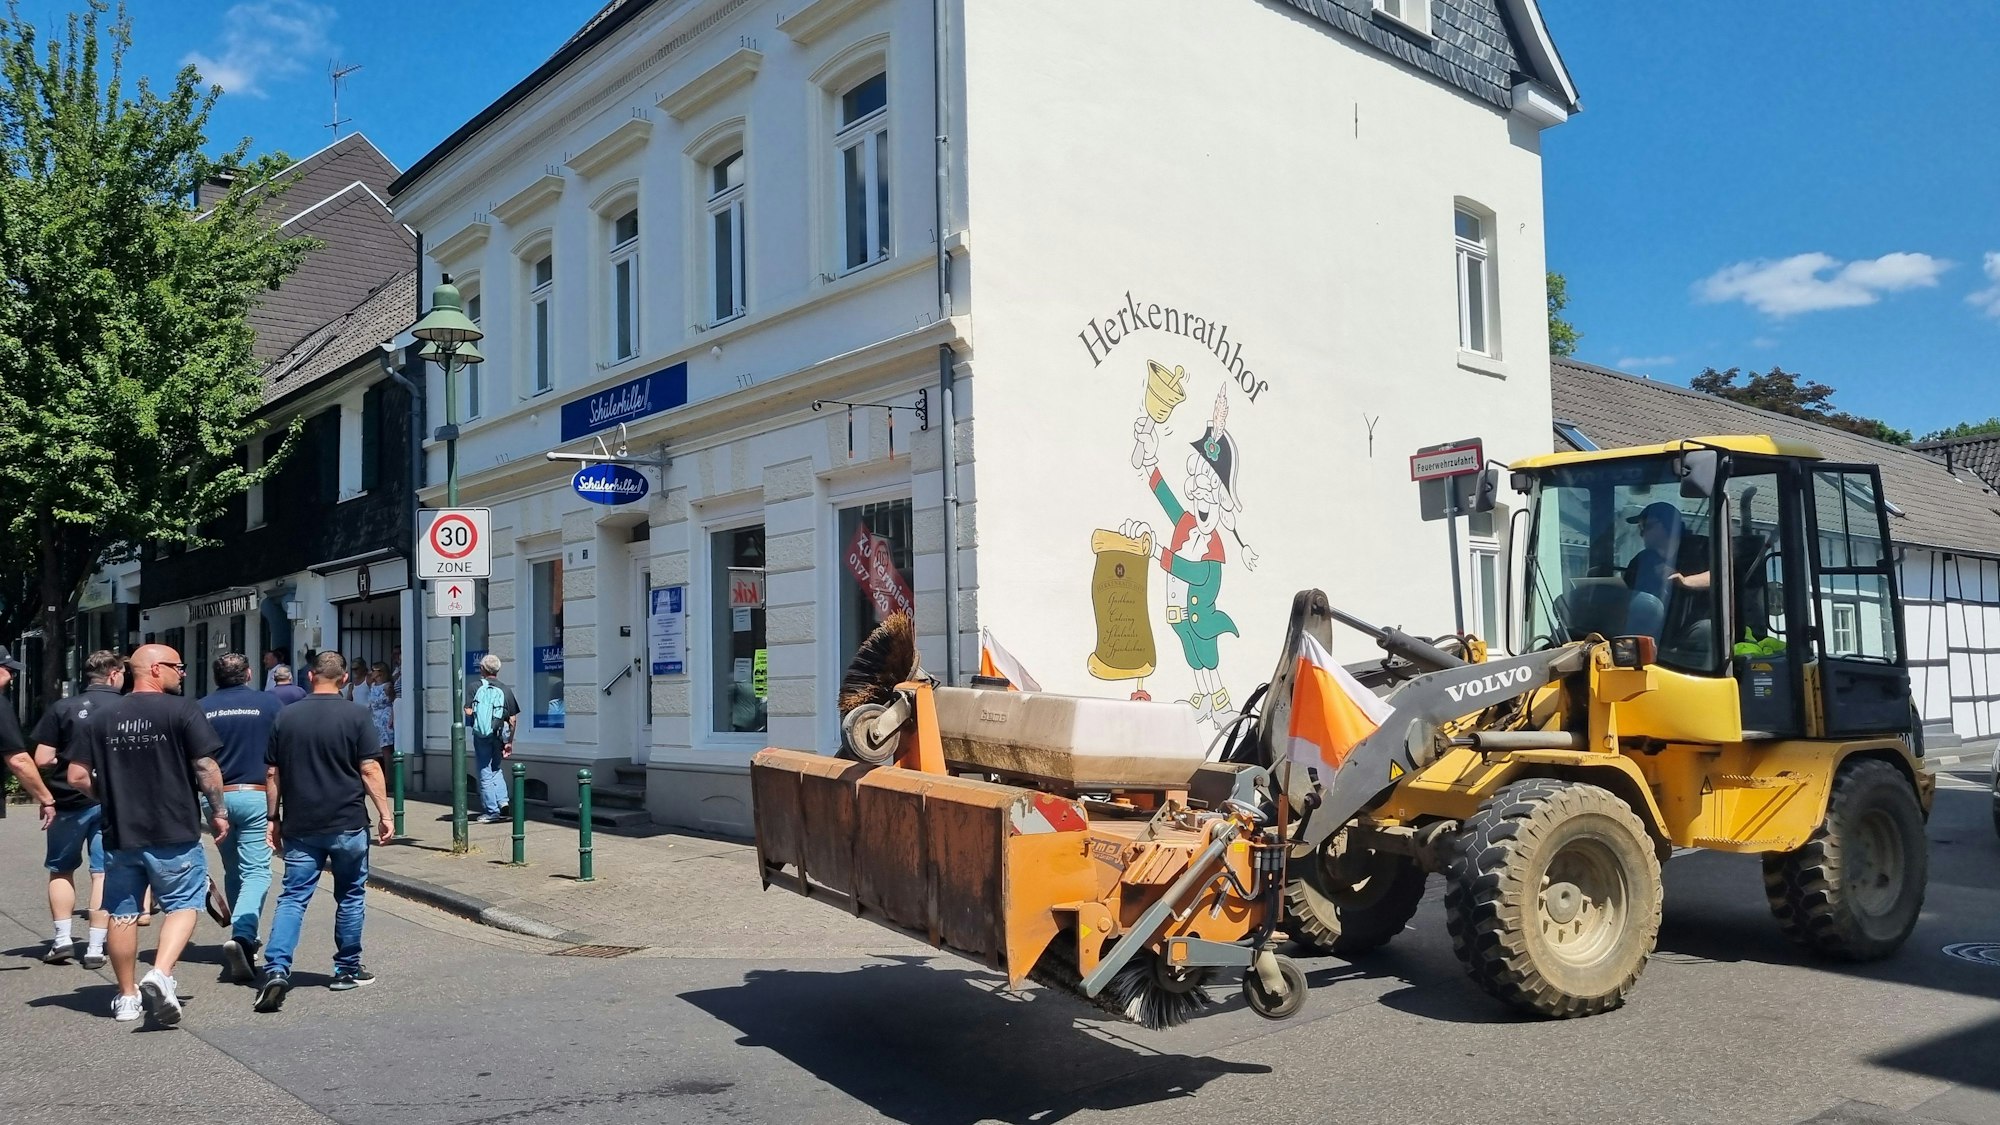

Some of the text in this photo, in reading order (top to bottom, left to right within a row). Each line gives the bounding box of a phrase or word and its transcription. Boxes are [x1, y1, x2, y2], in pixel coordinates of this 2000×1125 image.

[1078, 290, 1269, 404] Herkenrathhof
[589, 378, 650, 425] Schülerhilfe!
[1417, 455, 1474, 472] Feuerwehrzufahrt
[578, 476, 643, 494] Schülerhilfe!
[440, 527, 467, 546] 30
[437, 562, 472, 573] ZONE
[849, 553, 870, 581] 0177
[360, 574, 366, 591] H
[857, 533, 914, 621] Zu vermiete
[1445, 665, 1532, 702] VOLVO
[218, 708, 260, 716] Schlebusch
